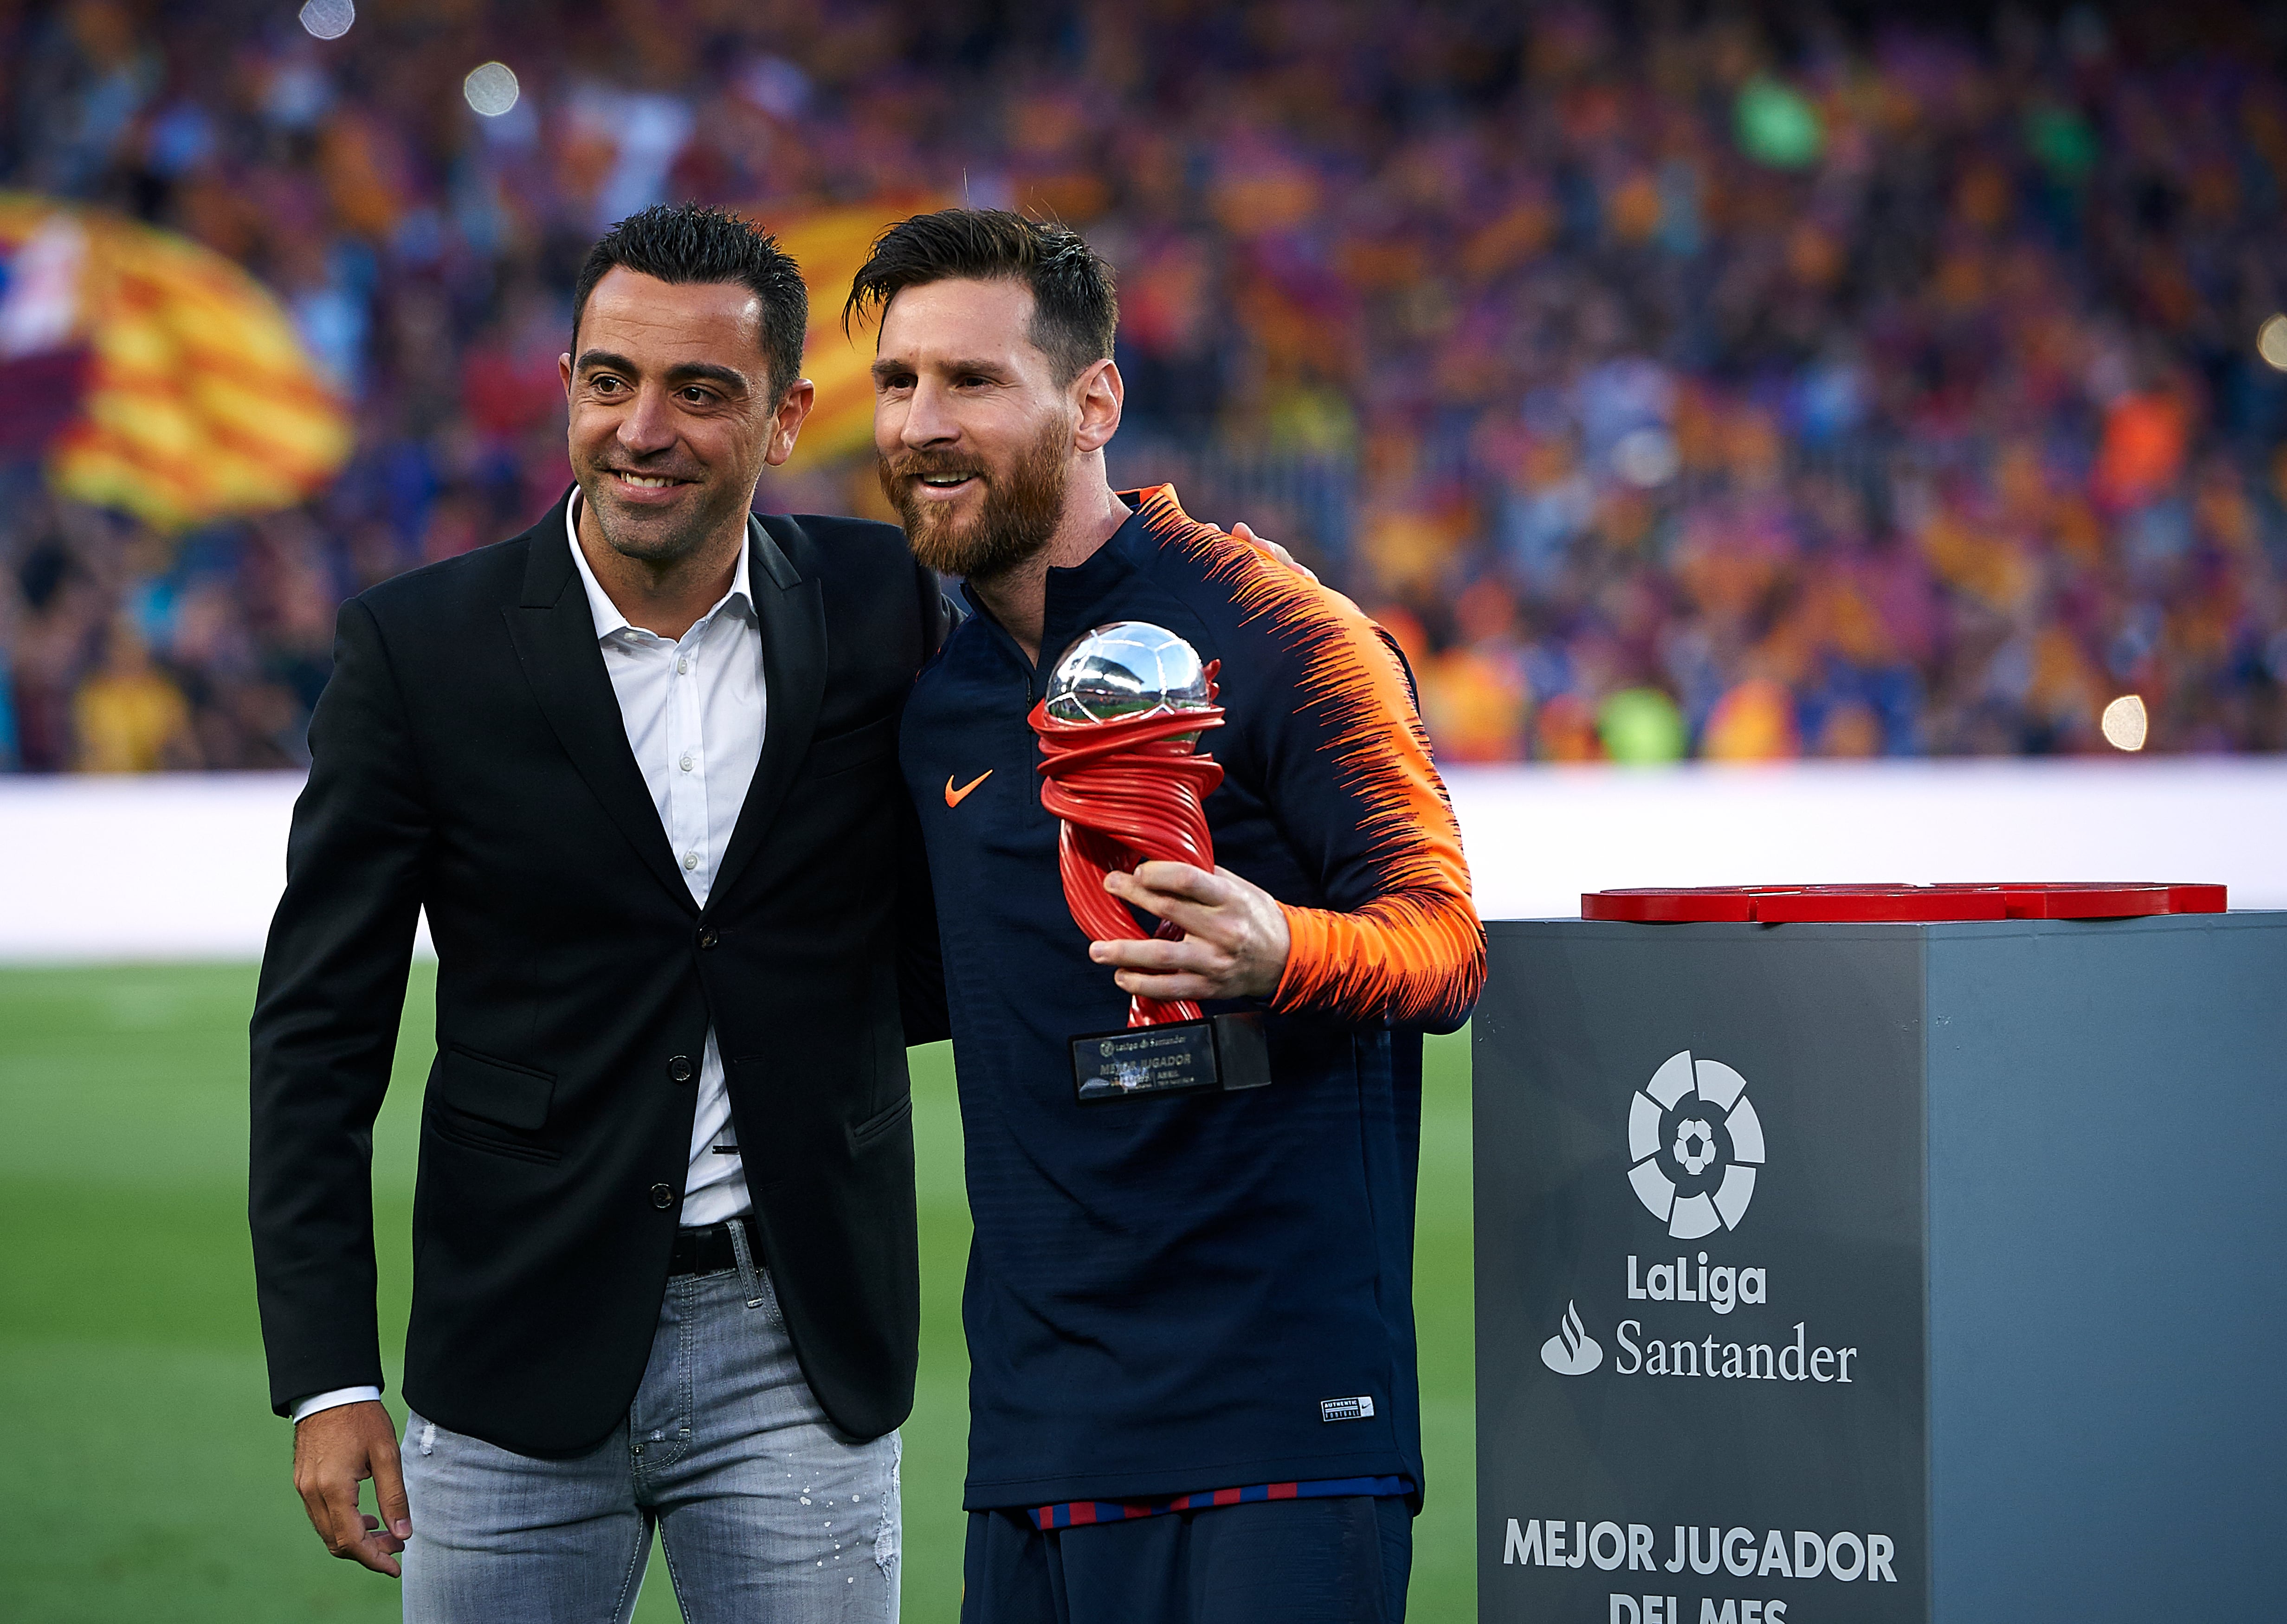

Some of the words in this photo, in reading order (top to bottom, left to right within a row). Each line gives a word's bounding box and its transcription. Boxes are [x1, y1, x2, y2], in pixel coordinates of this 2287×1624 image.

[1140, 1053, 1191, 1070] JUGADOR
[1628, 1251, 1766, 1314] LaLiga
[1616, 1320, 1857, 1383] Santander
[1325, 1410, 1359, 1418] FOOTBALL
[1503, 1518, 1657, 1571] MEJOR
[1664, 1526, 1898, 1582] JUGADOR
[1699, 1598, 1787, 1624] MES
